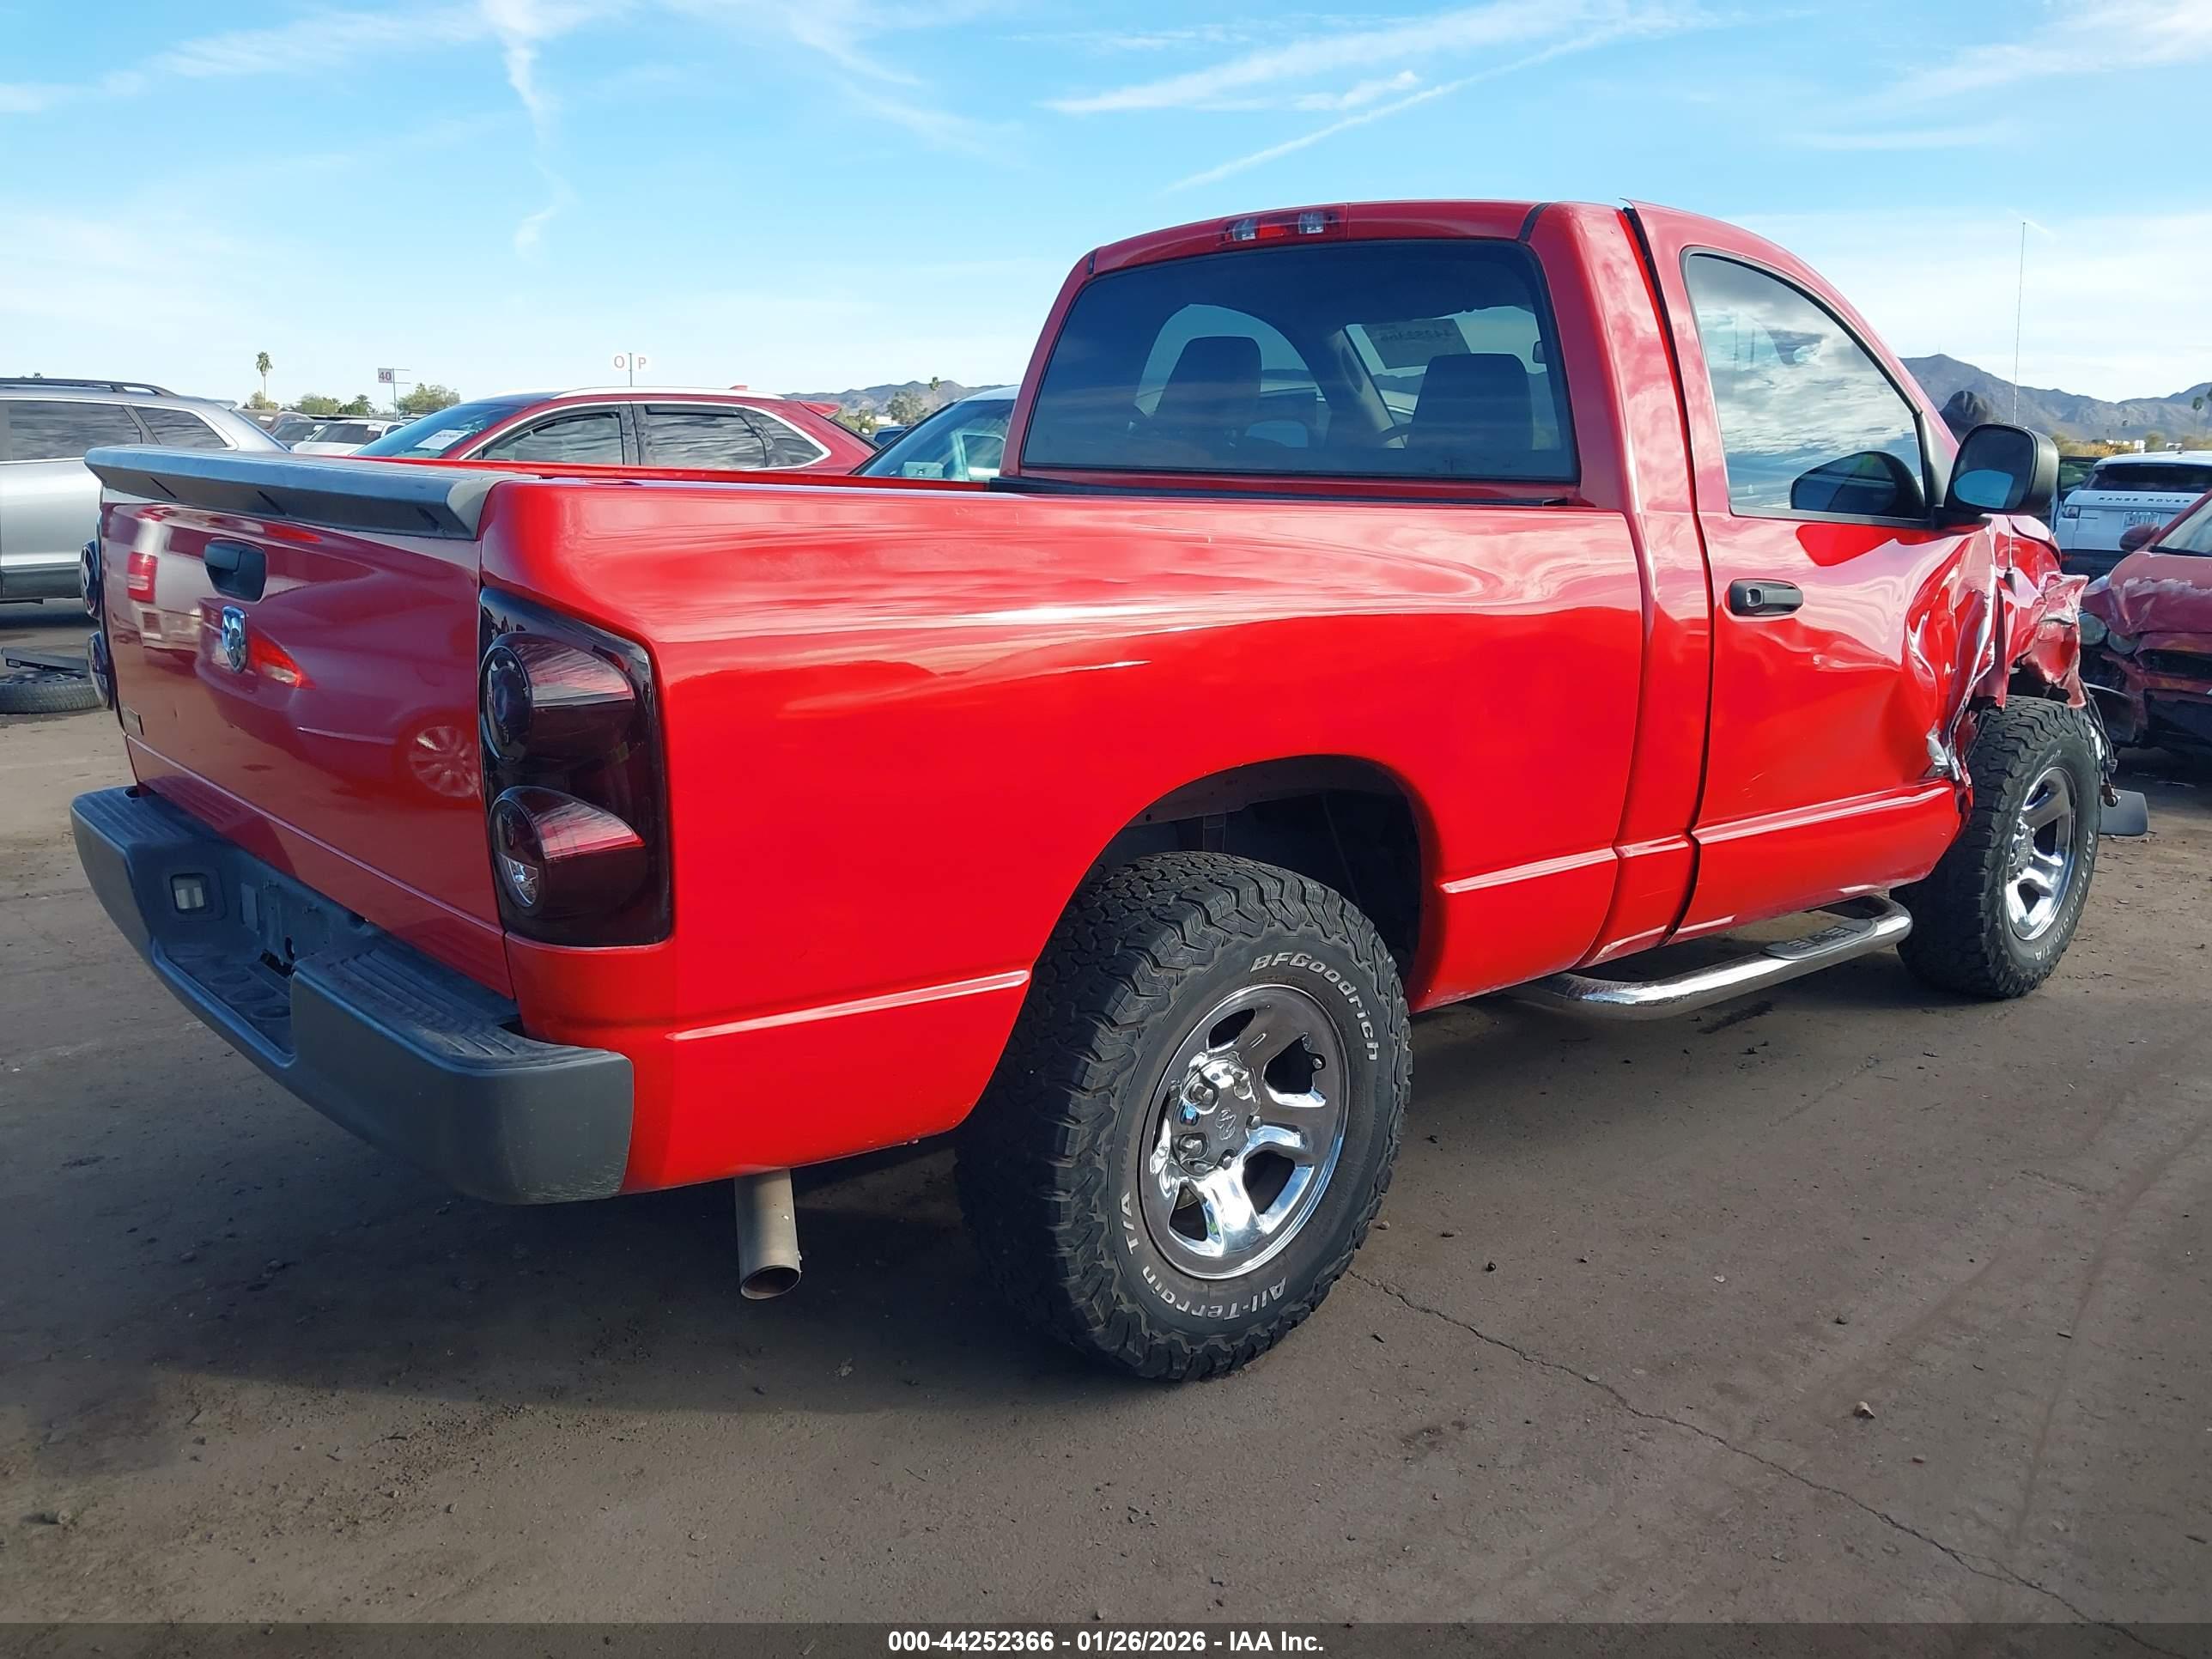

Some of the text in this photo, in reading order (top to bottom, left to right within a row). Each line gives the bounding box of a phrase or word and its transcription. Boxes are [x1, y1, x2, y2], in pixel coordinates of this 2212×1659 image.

[378, 371, 392, 381] 40
[638, 356, 647, 369] P
[1249, 951, 1381, 1061] BFGoodrich
[1119, 1190, 1288, 1322] All-Terrain T/A
